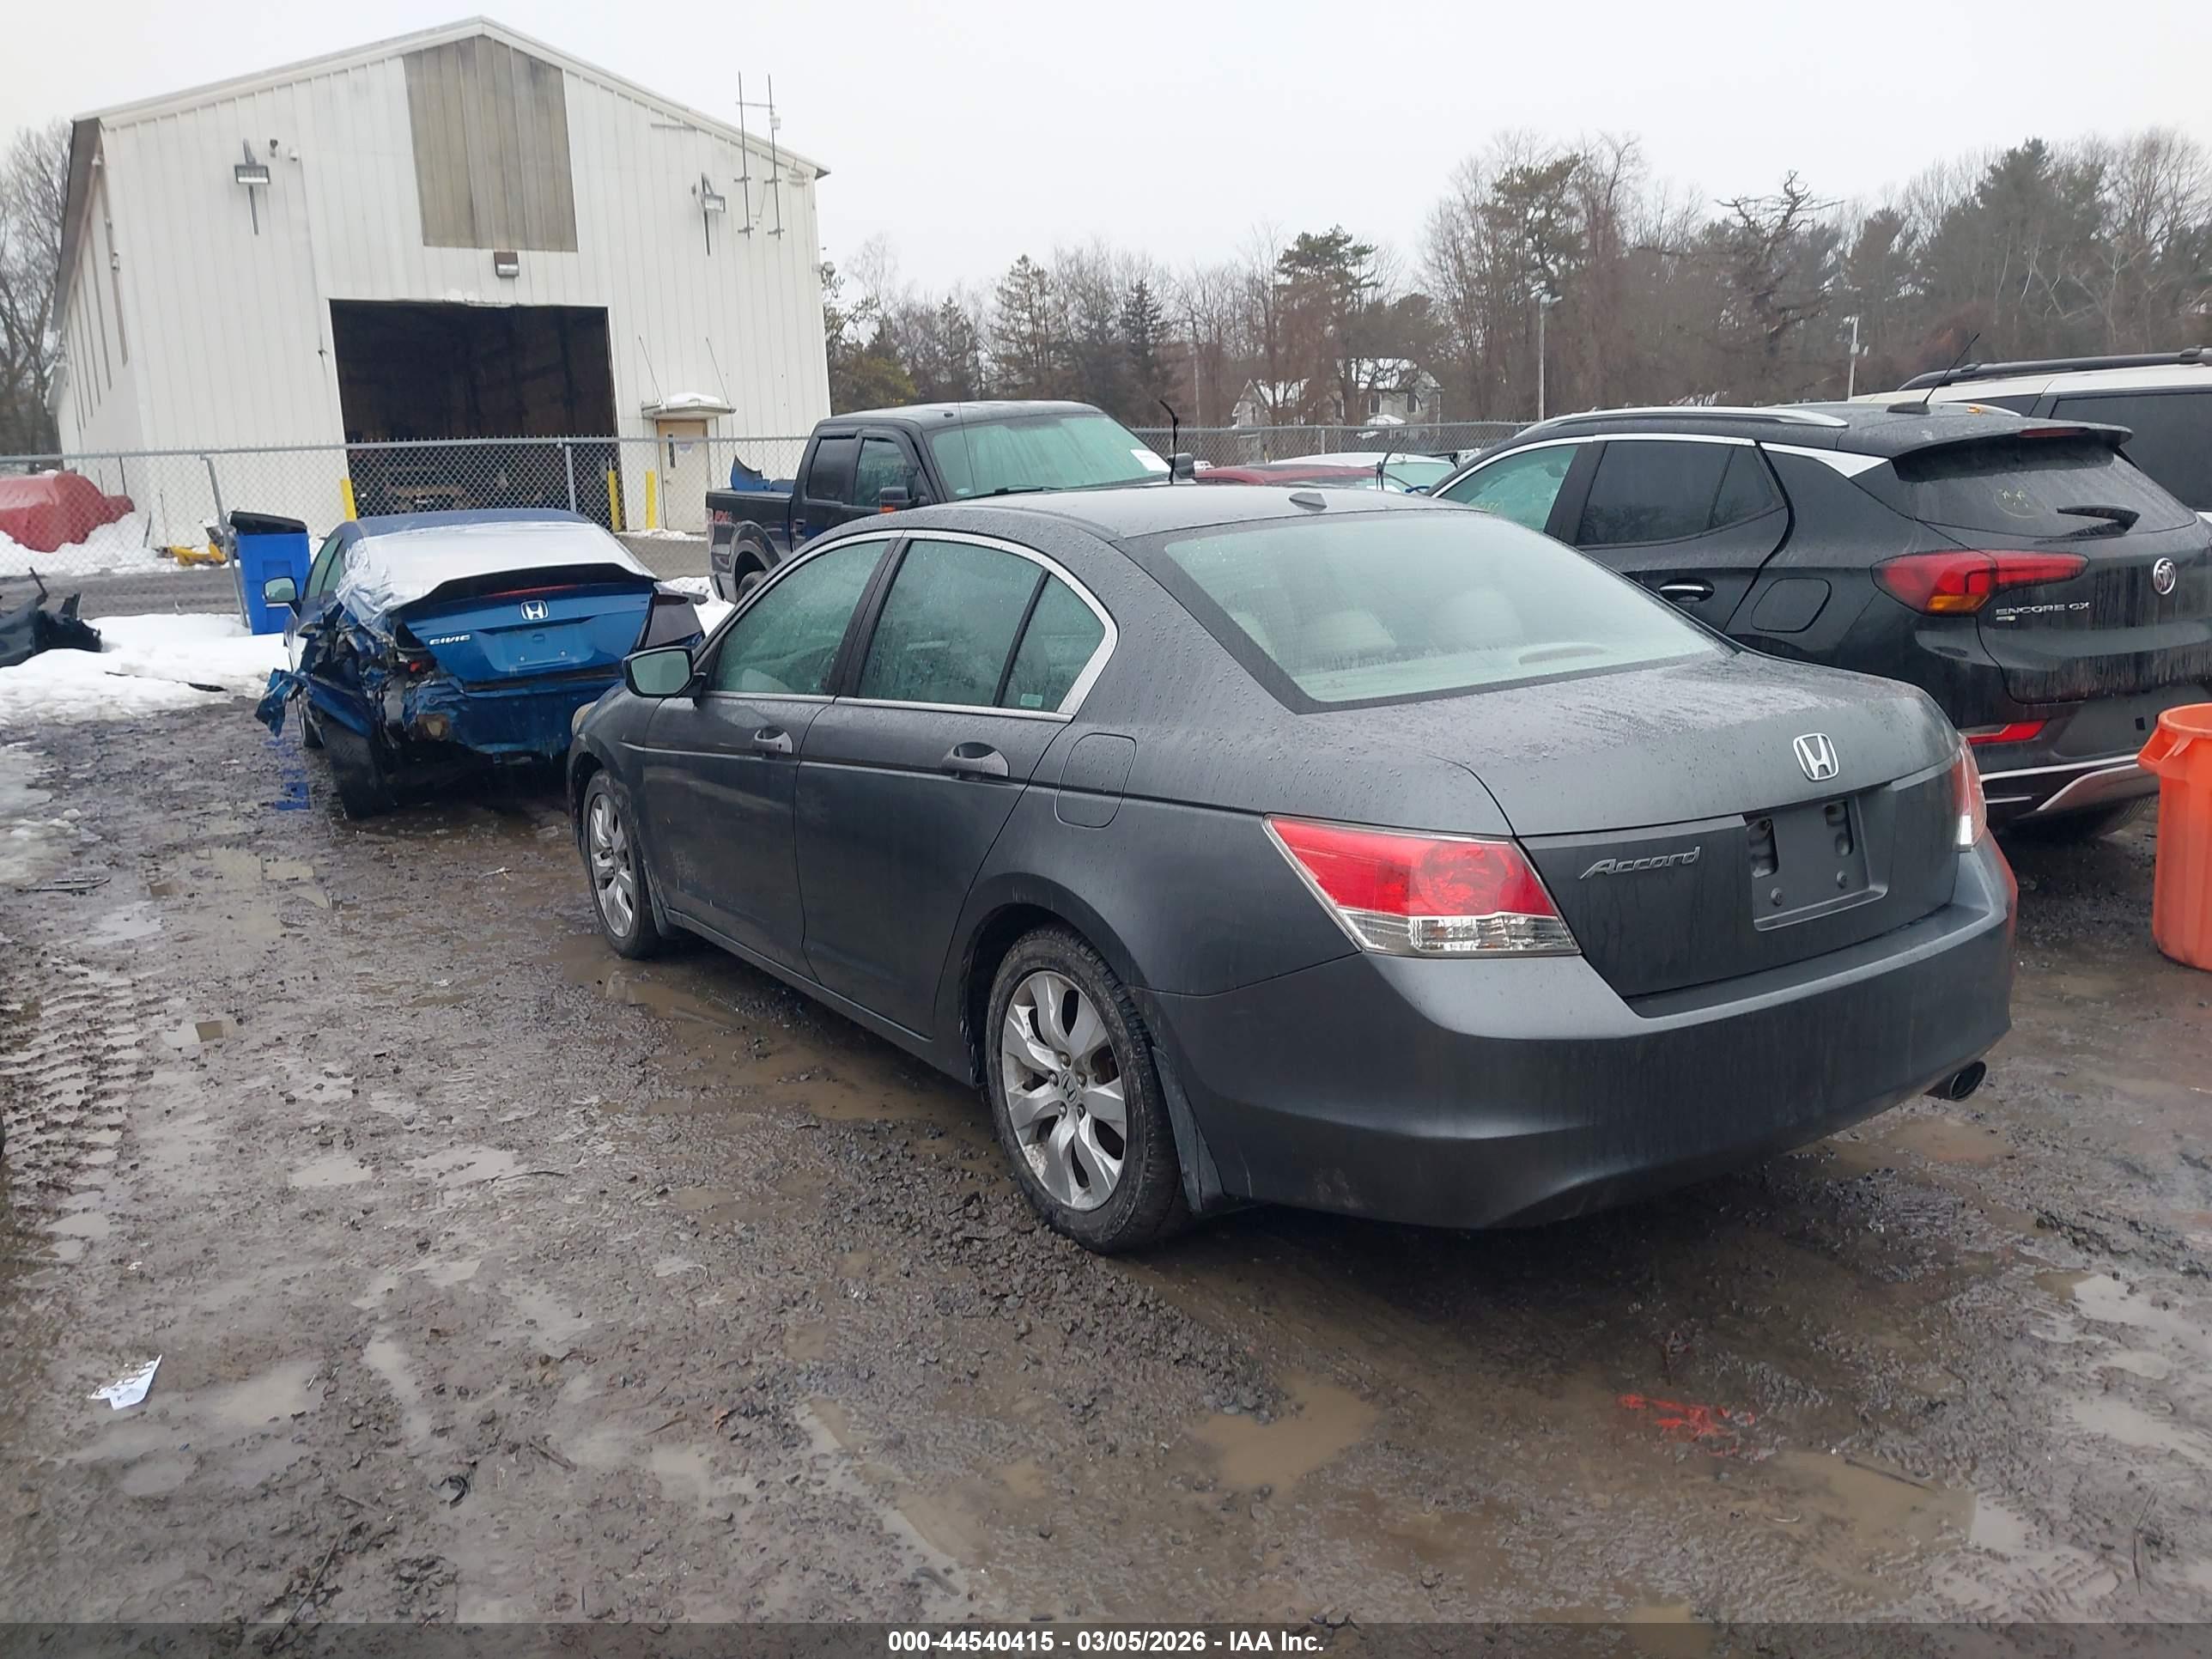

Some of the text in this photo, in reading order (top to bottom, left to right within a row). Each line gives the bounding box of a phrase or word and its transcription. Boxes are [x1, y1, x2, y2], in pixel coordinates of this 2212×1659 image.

[1996, 604, 2065, 616] ENCORE
[428, 634, 471, 645] CIVIC
[1578, 846, 1701, 880] Accord
